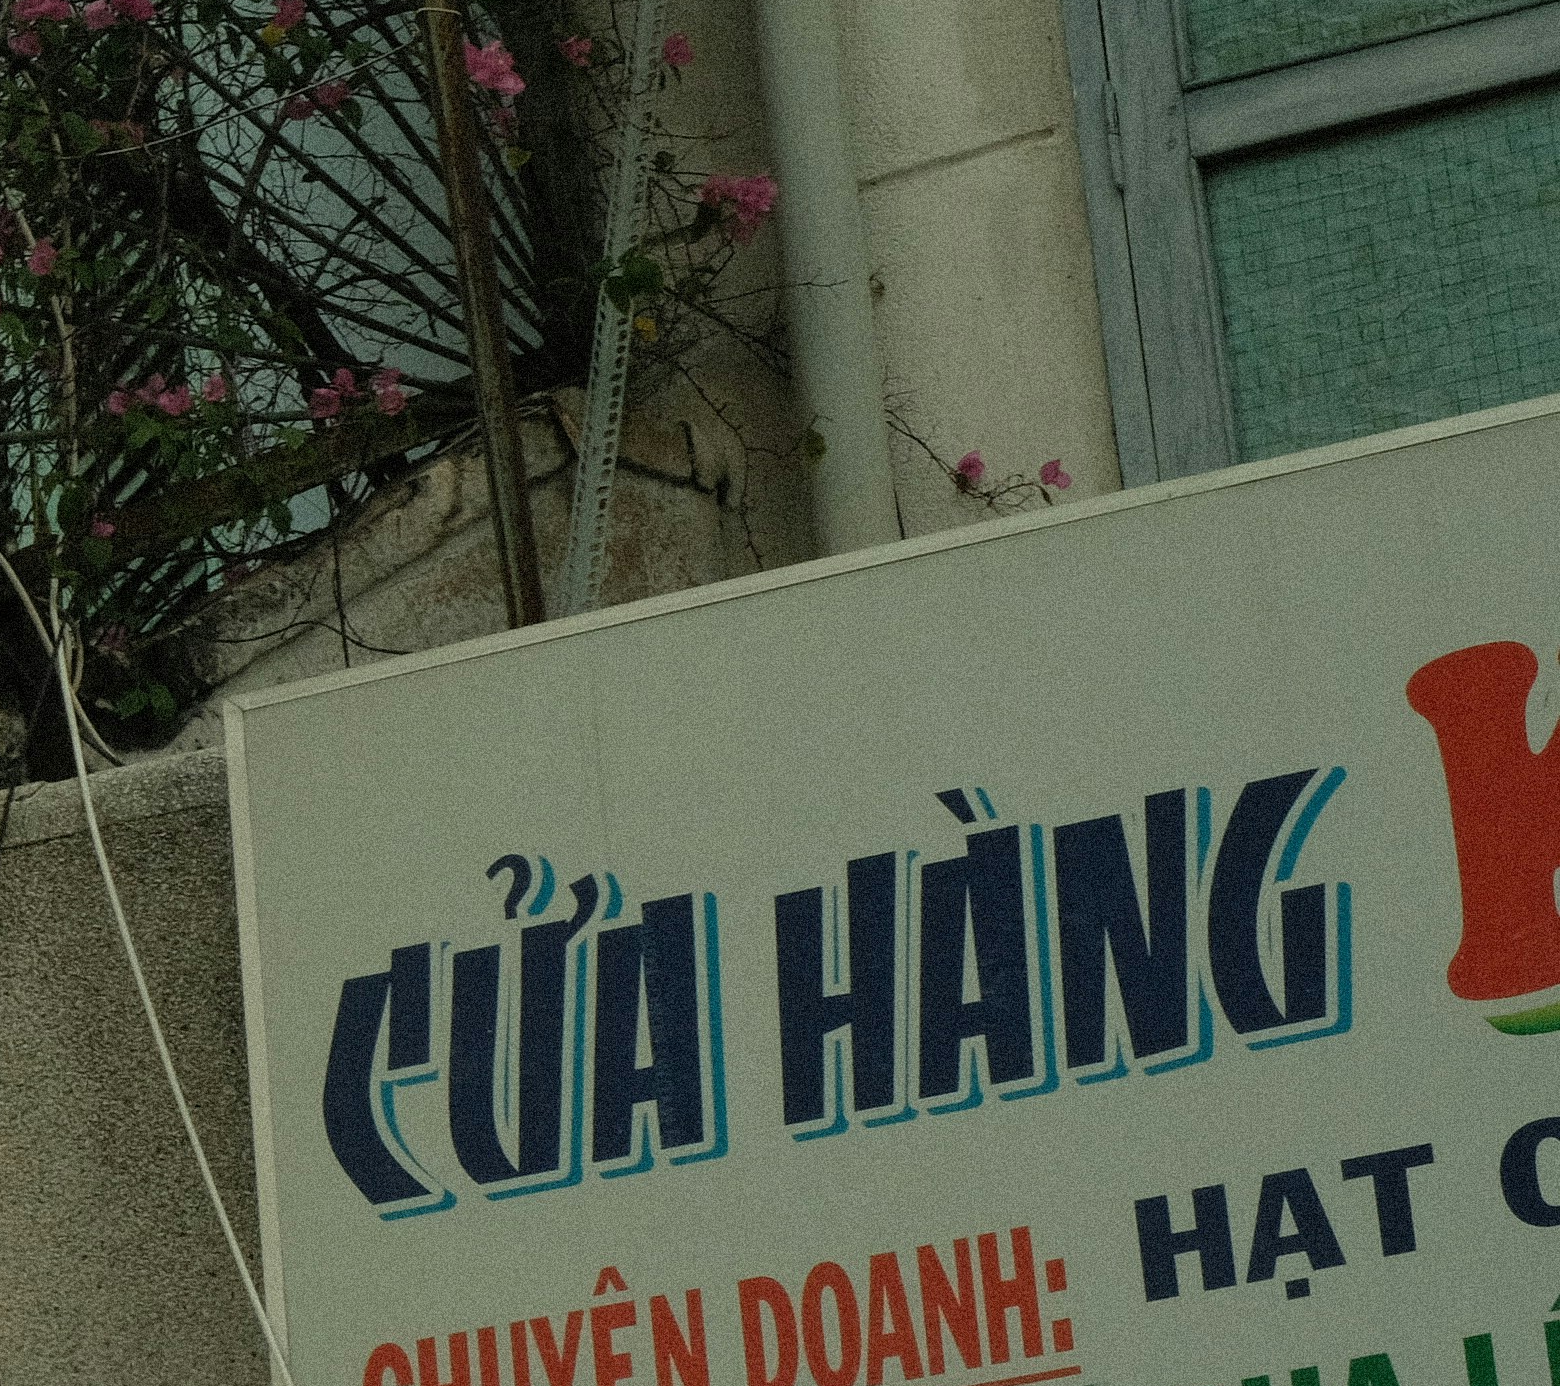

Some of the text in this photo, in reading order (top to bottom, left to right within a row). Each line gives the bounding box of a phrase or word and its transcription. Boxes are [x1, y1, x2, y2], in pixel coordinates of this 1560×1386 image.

[322, 853, 728, 1222] CỬA
[774, 766, 1352, 1143] HÀNG
[1134, 1143, 1434, 1303] HẠT
